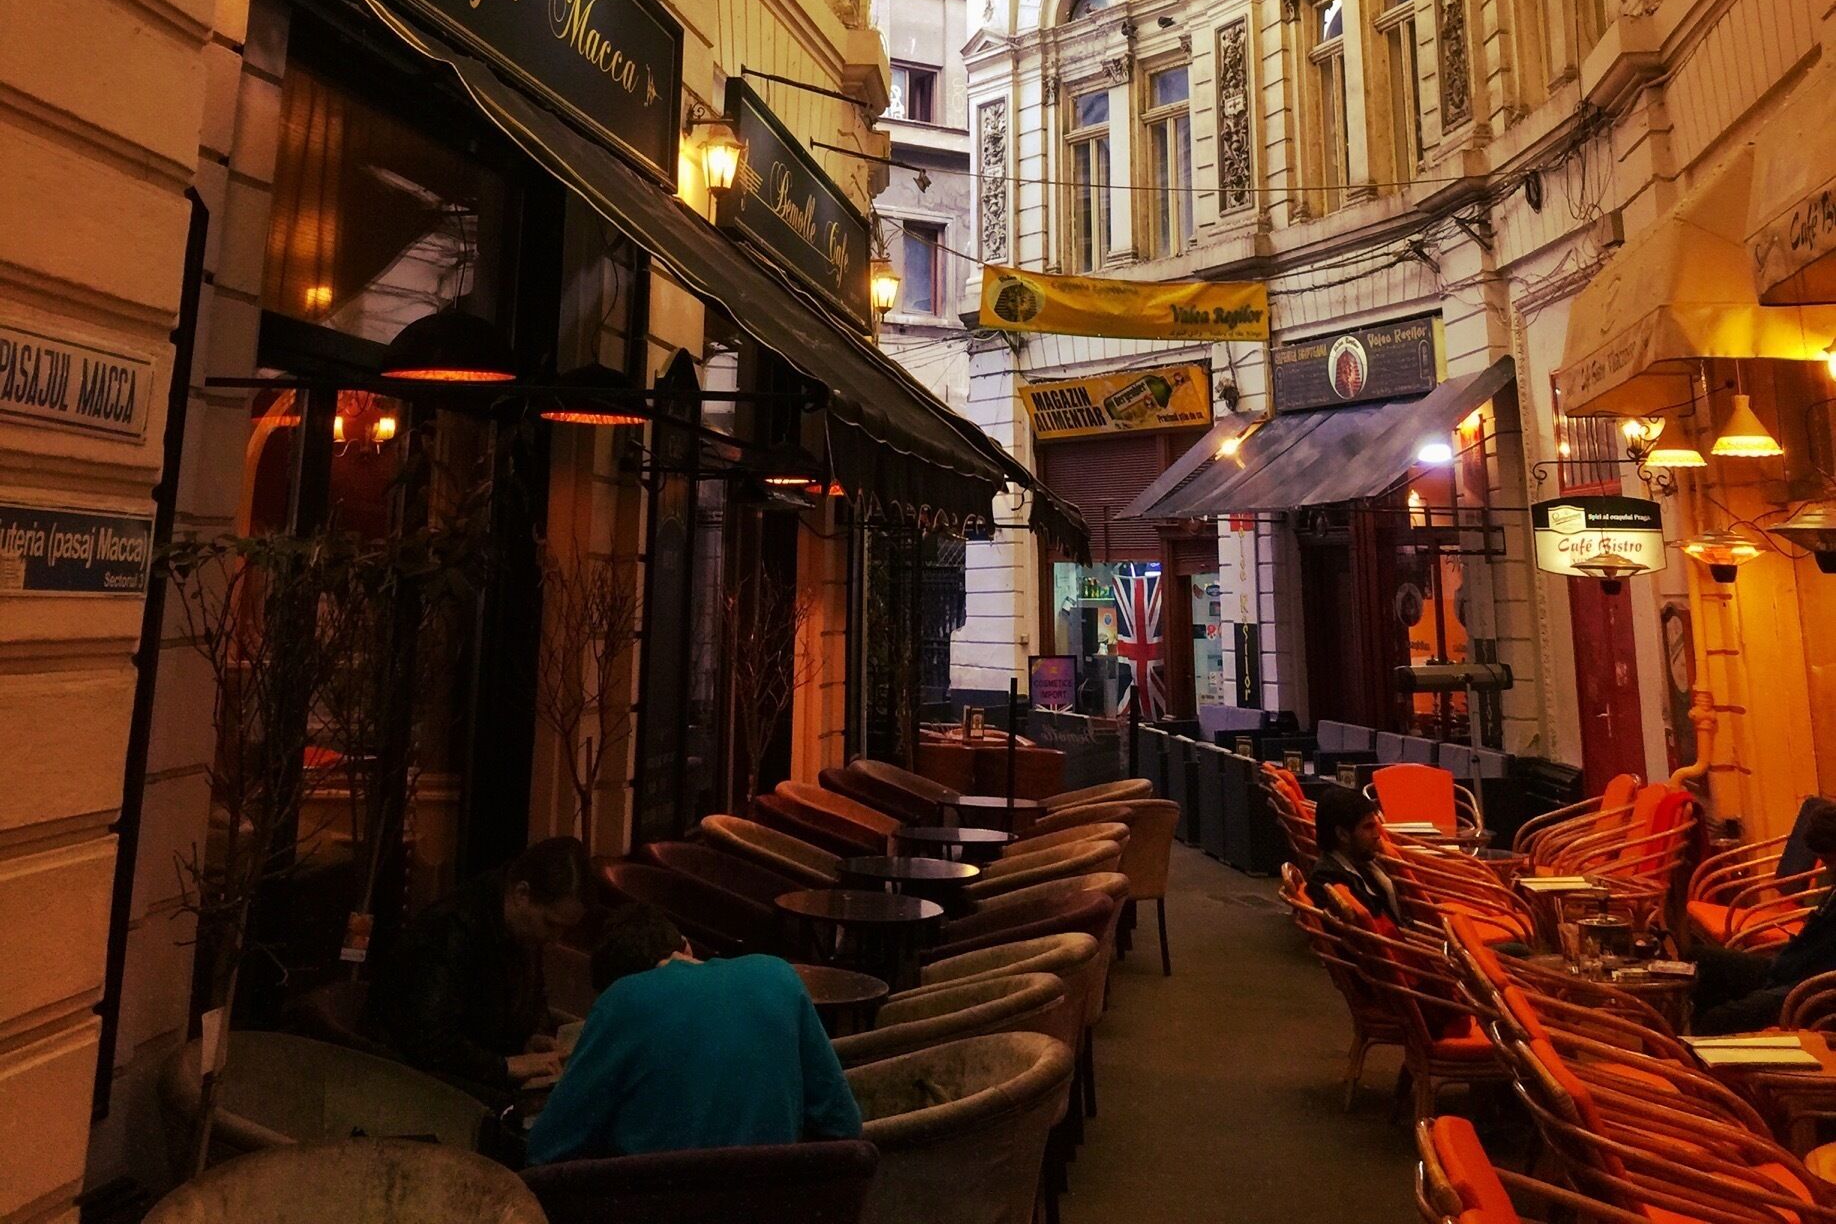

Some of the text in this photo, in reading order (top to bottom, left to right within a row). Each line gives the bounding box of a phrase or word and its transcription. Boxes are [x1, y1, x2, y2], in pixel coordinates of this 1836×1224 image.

[770, 160, 817, 245] Bemolle
[0, 338, 136, 424] PASAJUL MACCA
[1031, 386, 1092, 411] MAGAZIN
[1033, 406, 1108, 432] ALIMENTAR
[0, 518, 148, 571] uteria (pasaj Macca)
[1557, 537, 1642, 556] Café Bistro
